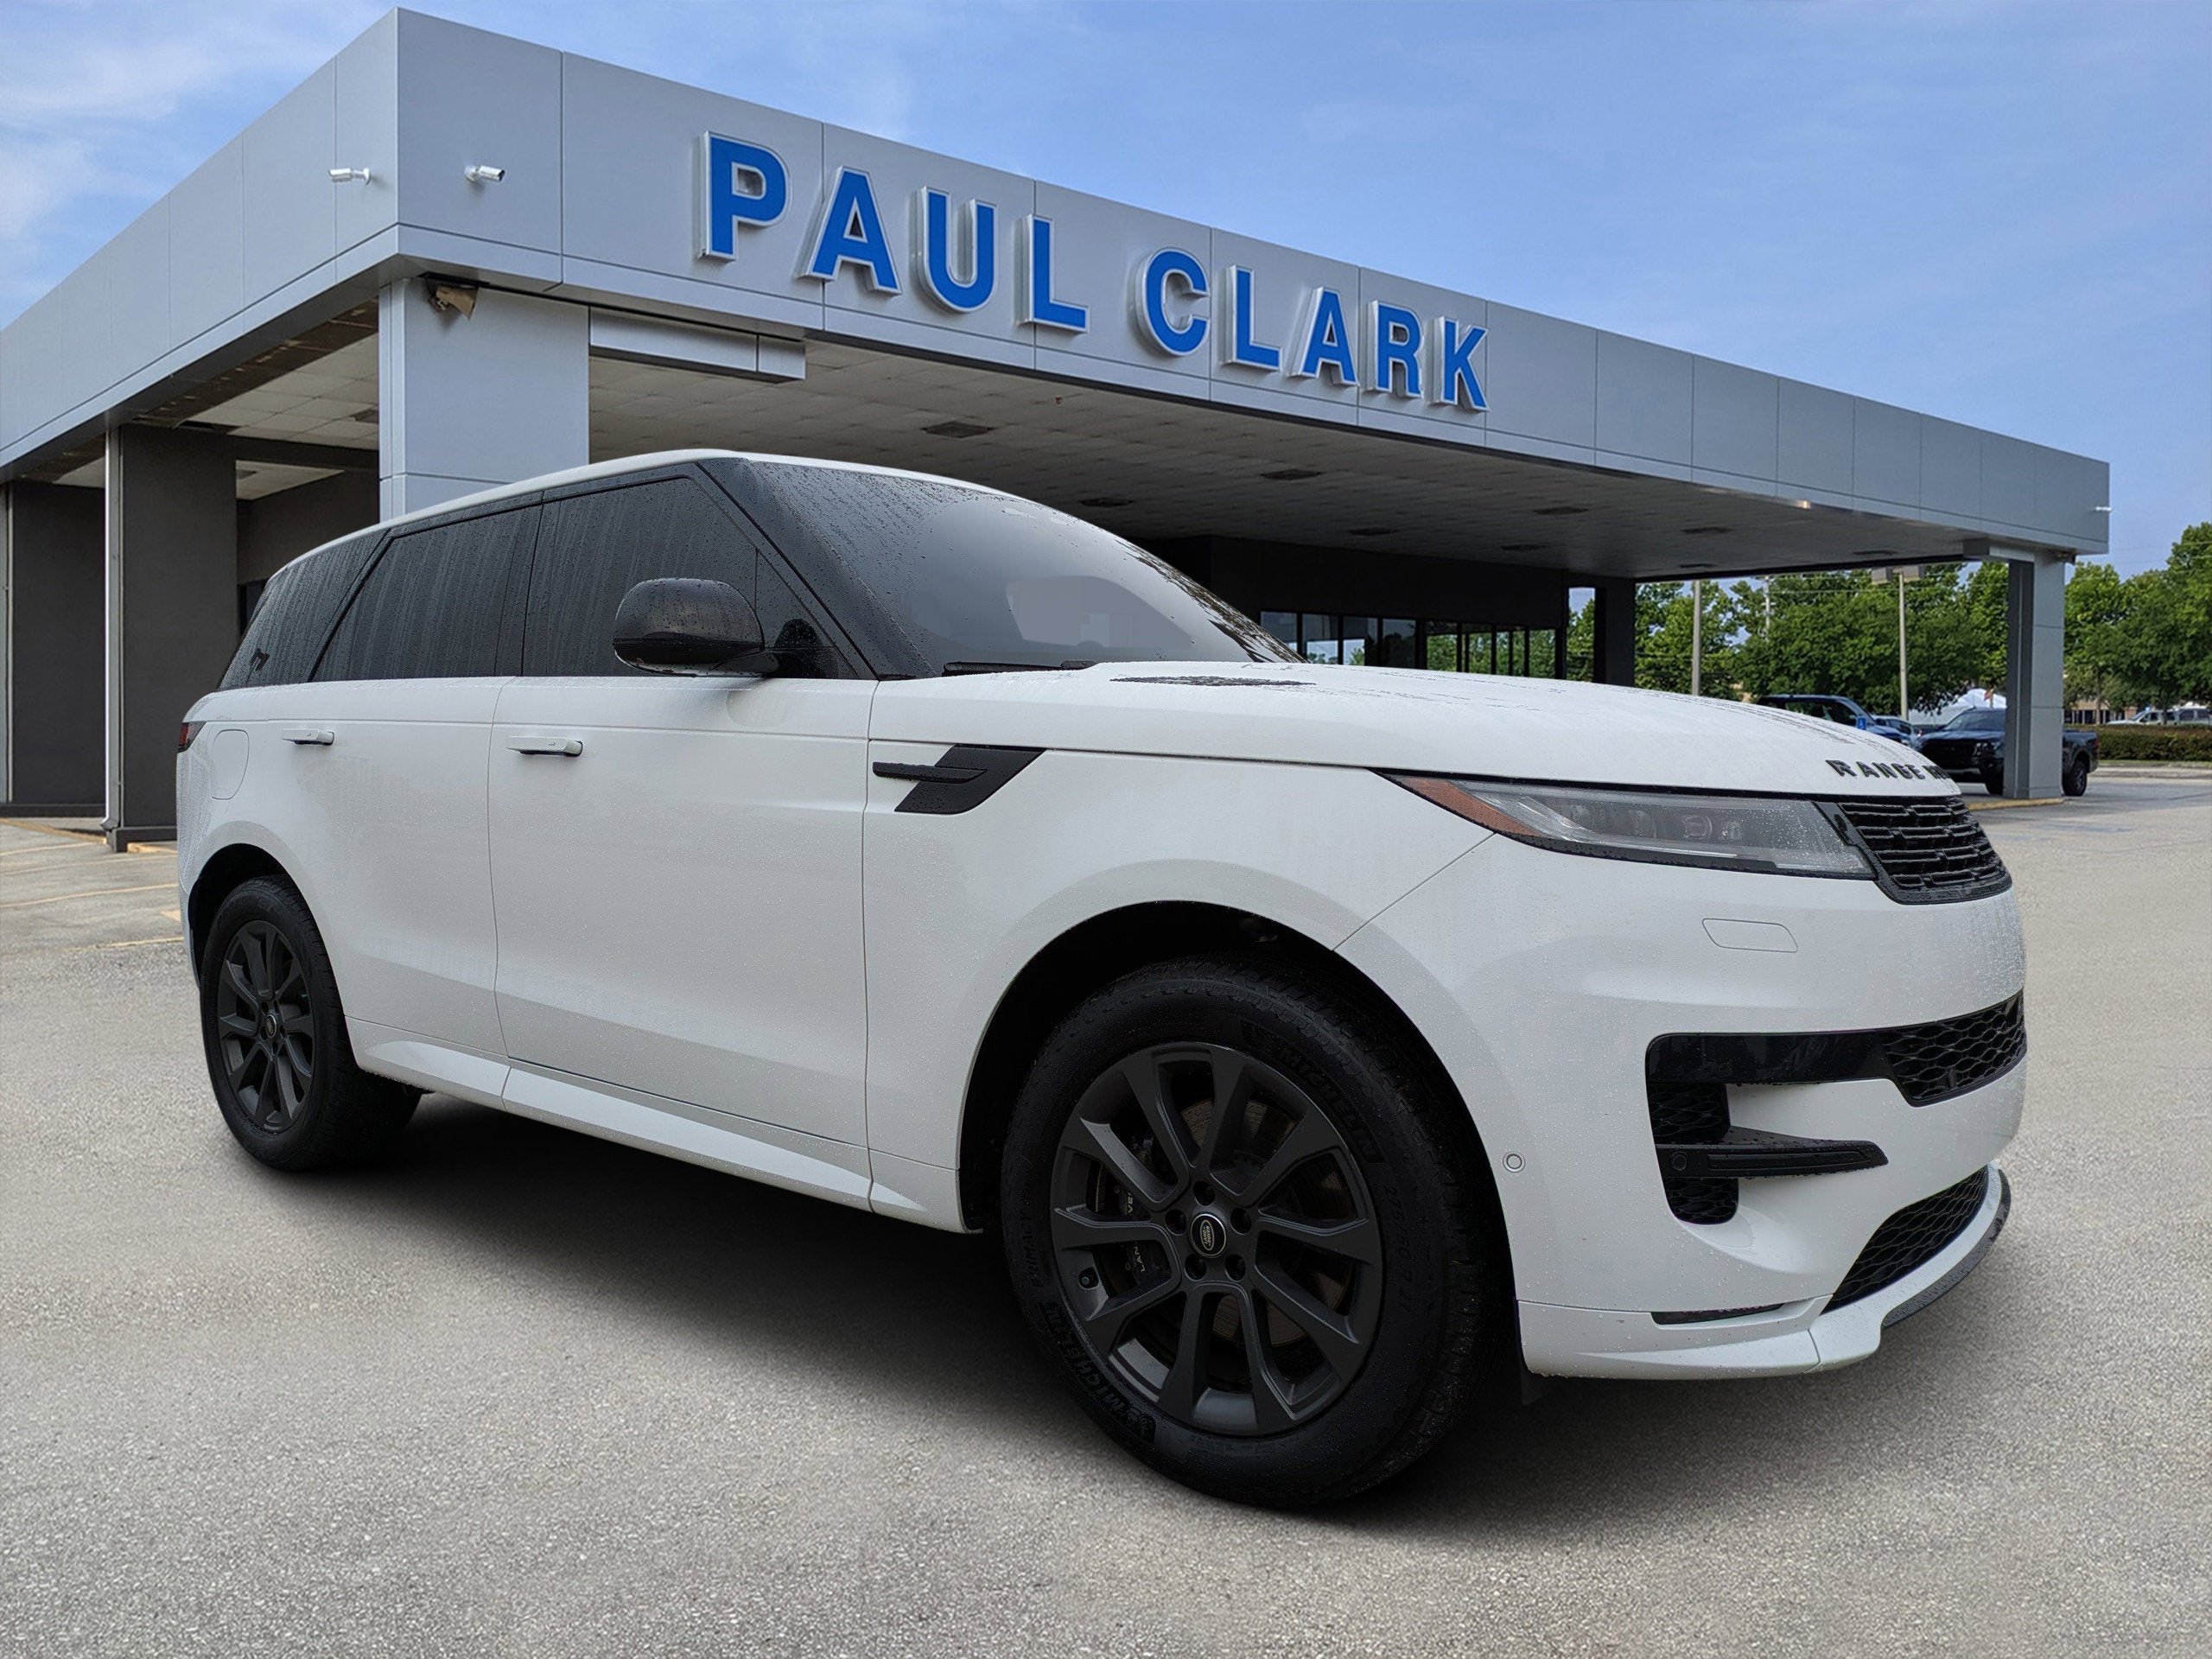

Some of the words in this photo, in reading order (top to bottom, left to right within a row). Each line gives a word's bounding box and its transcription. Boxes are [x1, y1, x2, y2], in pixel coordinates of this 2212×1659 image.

[700, 131, 1089, 333] PAUL
[1137, 247, 1490, 411] CLARK
[1825, 759, 1926, 779] RANGE
